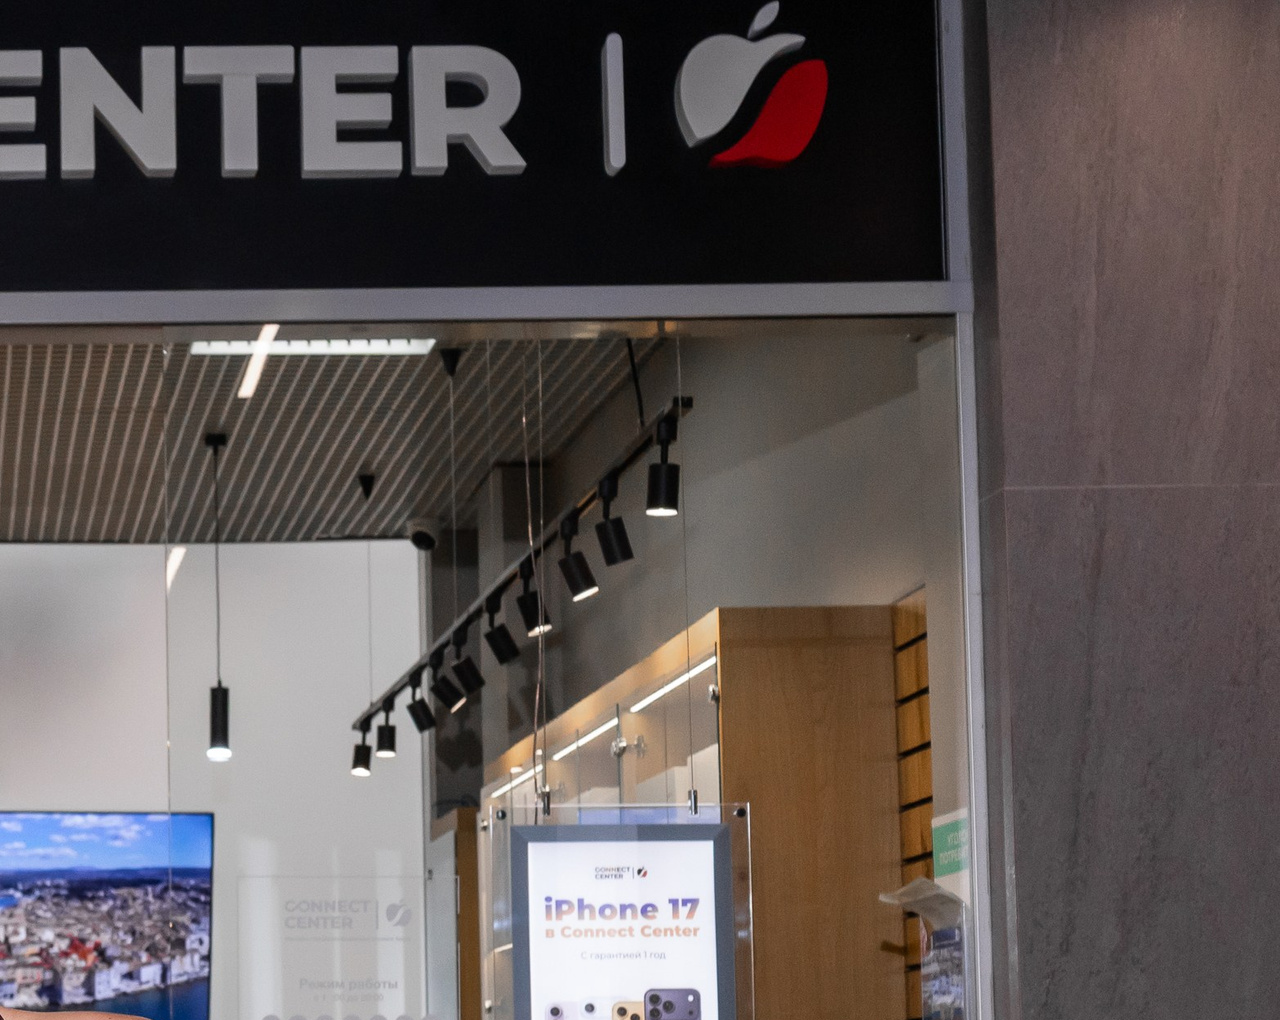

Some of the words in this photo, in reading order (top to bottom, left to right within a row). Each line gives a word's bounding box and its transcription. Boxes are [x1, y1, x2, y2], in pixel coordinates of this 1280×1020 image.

[284, 900, 371, 913] CONNECT
[544, 896, 659, 921] iPhone
[668, 898, 700, 921] 17
[284, 916, 353, 930] CENTER
[545, 928, 555, 939] в
[560, 925, 636, 939] Connect
[640, 925, 700, 938] Center
[589, 950, 642, 961] гарантией
[649, 951, 667, 961] год
[299, 979, 345, 989] Режим
[349, 979, 398, 991] работы
